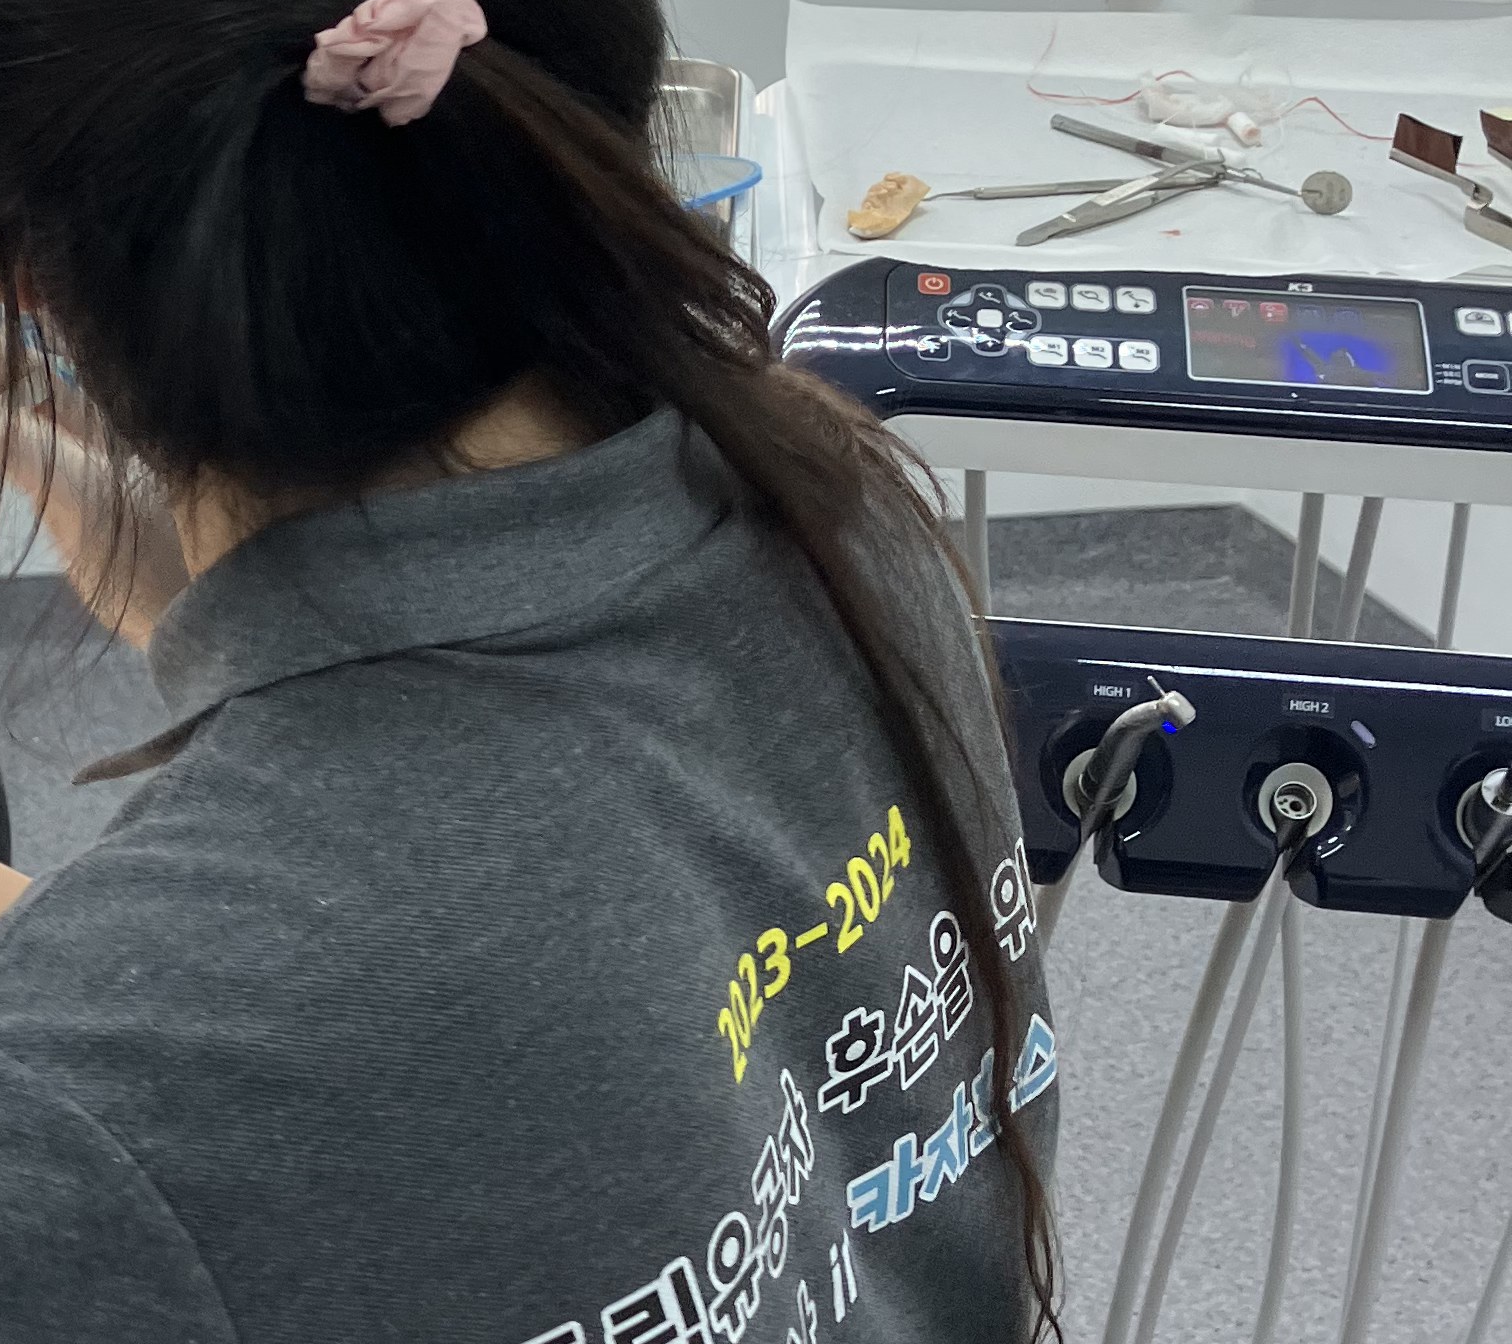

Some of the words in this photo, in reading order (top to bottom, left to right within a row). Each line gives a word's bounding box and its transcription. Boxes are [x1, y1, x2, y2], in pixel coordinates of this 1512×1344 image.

[1289, 282, 1314, 294] K3
[1092, 684, 1124, 698] HIGH
[1124, 686, 1132, 699] 1
[1289, 699, 1318, 713] HIGH
[1319, 701, 1330, 715] 2
[718, 805, 912, 1083] 2023-2024
[818, 910, 974, 1114] 후손을
[990, 836, 1037, 962] 위
